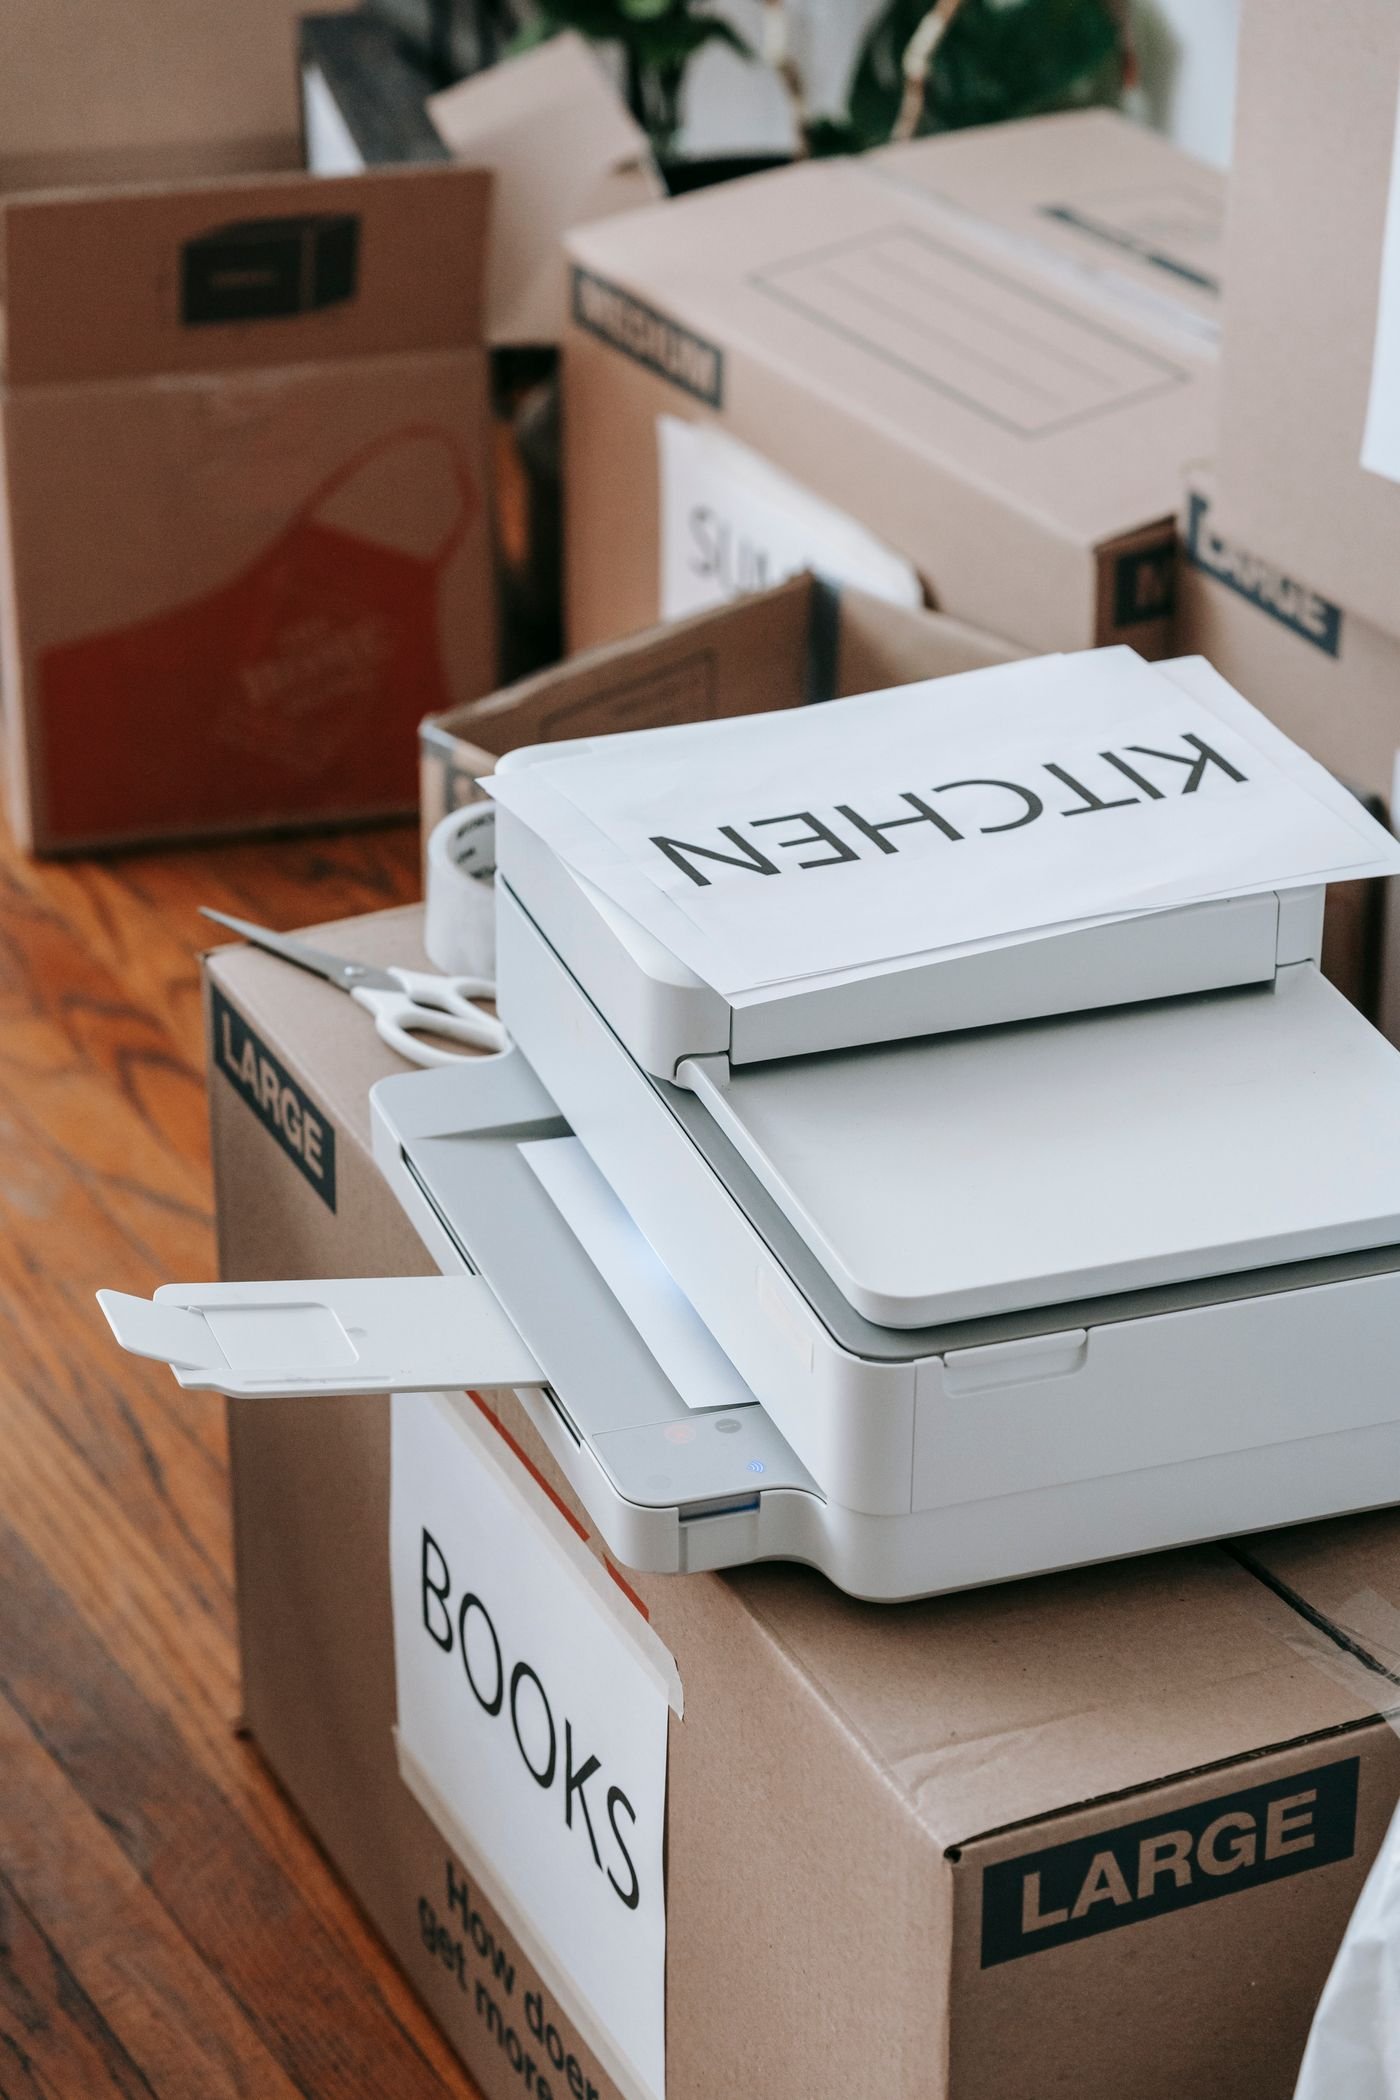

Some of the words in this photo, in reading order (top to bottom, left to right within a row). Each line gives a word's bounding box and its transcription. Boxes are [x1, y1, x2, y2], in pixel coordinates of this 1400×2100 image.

[648, 733, 1249, 887] KITCHEN
[221, 1010, 324, 1180] LARGE
[422, 1526, 640, 1911] BOOKS
[446, 1858, 516, 1996] How
[1021, 1788, 1318, 1935] LARGE
